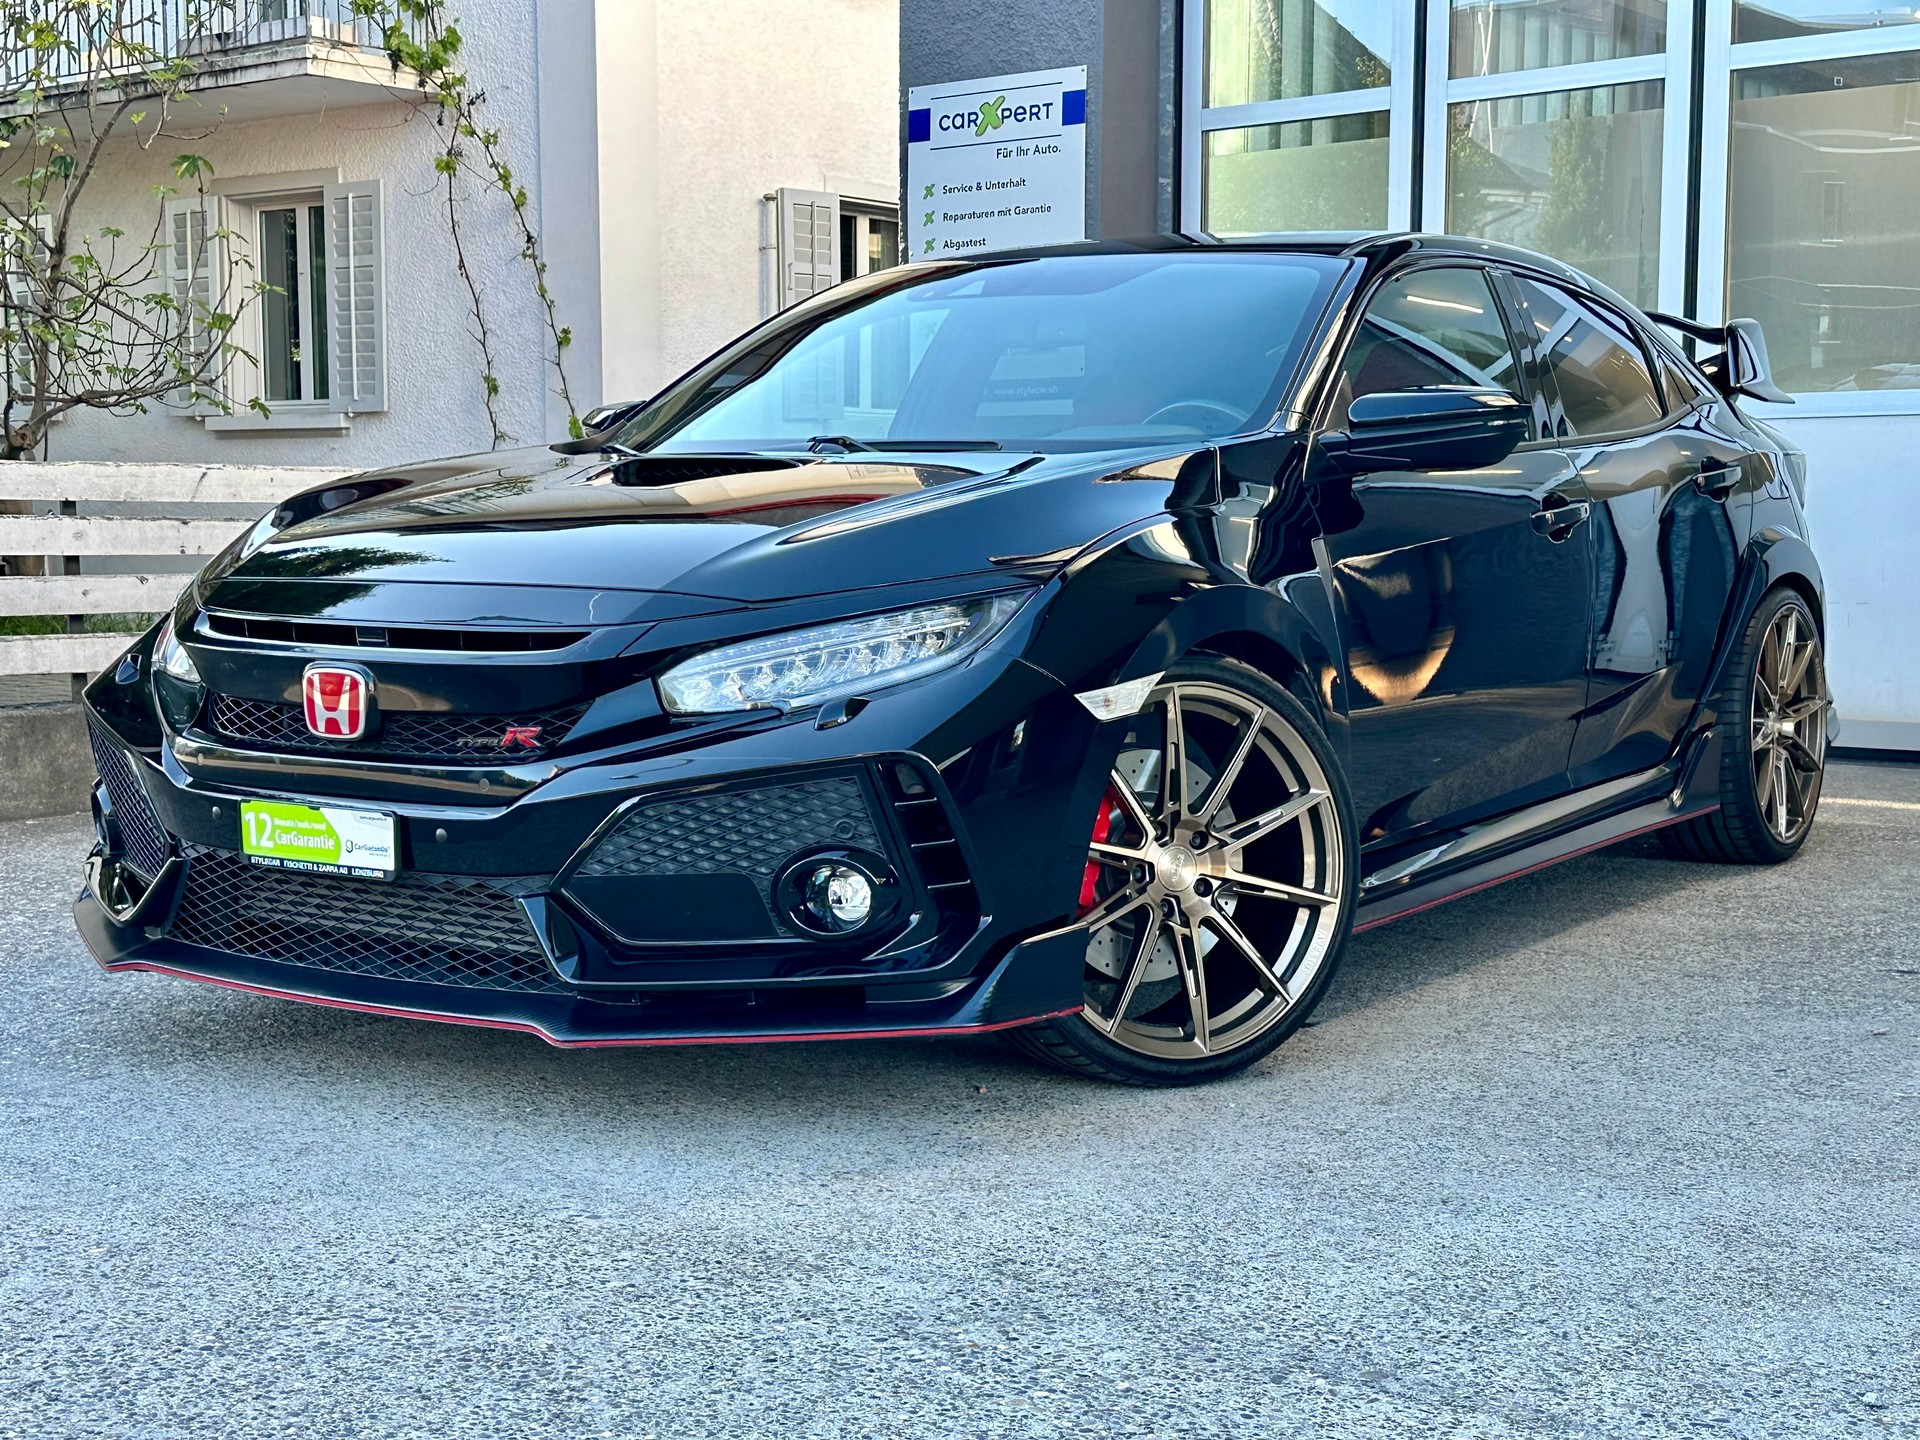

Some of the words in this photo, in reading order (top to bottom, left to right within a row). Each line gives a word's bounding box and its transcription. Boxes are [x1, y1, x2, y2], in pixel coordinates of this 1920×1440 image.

[996, 147, 1014, 159] Für
[1016, 145, 1031, 157] Ihr
[1033, 144, 1062, 156] Auto.
[942, 184, 973, 195] Service
[975, 182, 983, 191] &
[985, 177, 1027, 190] Unterhalt
[942, 209, 995, 223] Reparaturen
[997, 206, 1012, 217] mit
[1014, 203, 1052, 215] Garantie
[942, 237, 987, 251] Abgastest
[500, 726, 542, 748] R
[244, 811, 274, 849] 12
[275, 829, 335, 850] CarGarantie
